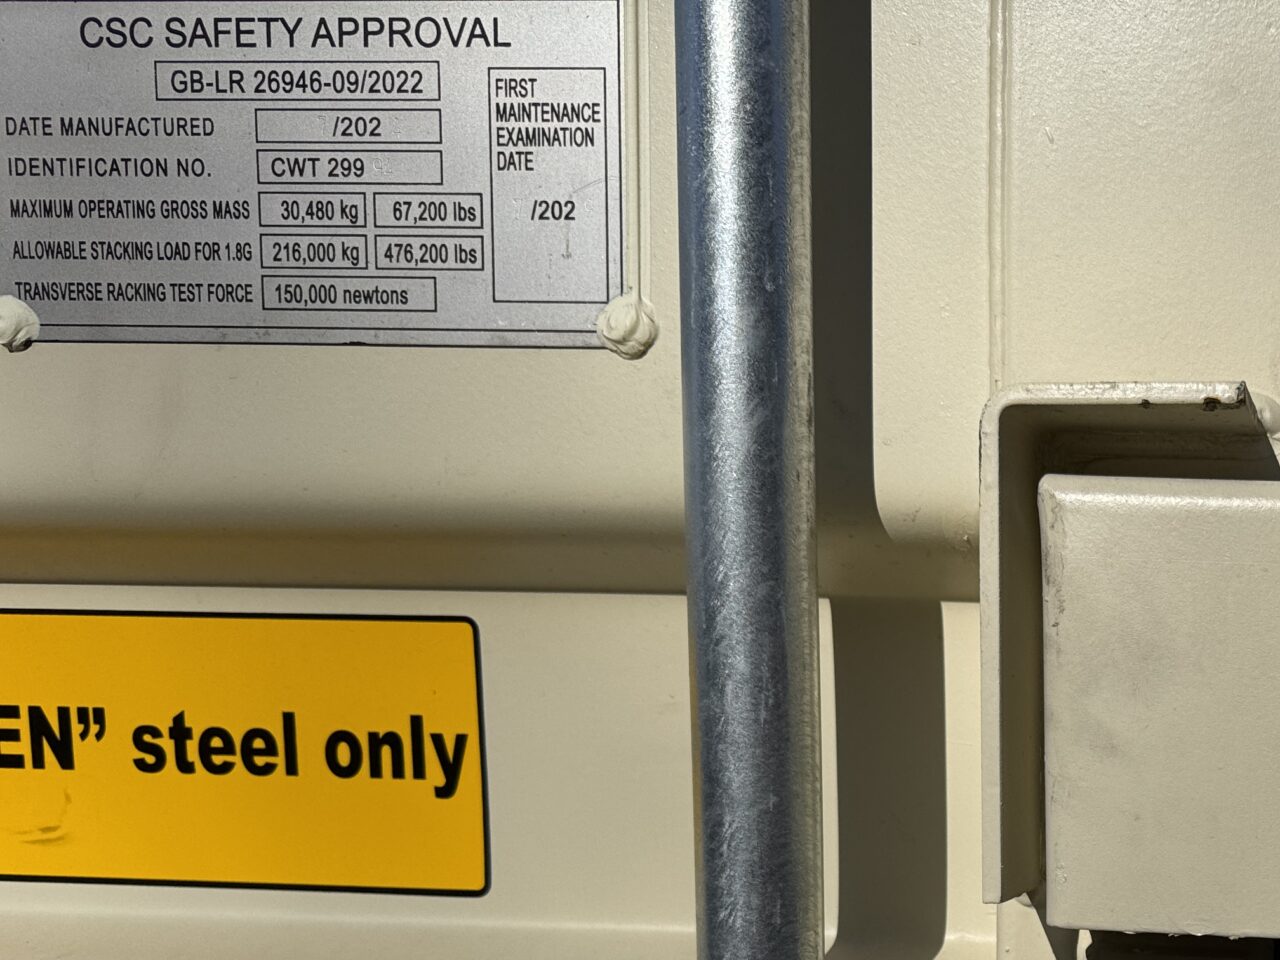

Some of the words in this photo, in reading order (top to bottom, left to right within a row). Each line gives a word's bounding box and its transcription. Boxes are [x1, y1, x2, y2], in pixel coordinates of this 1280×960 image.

[80, 17, 153, 48] CSC
[165, 17, 302, 48] SAFETY
[311, 17, 511, 48] APPROVAL
[171, 70, 245, 93] GB-LR
[254, 70, 422, 93] 26946-09/2022
[496, 79, 537, 98] FIRST
[496, 103, 600, 122] MAINTENANCE
[6, 117, 53, 136] DATE
[60, 117, 214, 136] MANUFACTURED
[497, 127, 594, 147] EXAMINATION
[9, 158, 167, 177] IDENTIFICATION
[177, 158, 211, 177] NO.
[271, 158, 320, 177] CWT
[497, 152, 534, 171] DATE
[10, 200, 73, 218] MAXIMUM
[79, 200, 155, 219] OPERATING
[161, 200, 208, 219] GROSS
[213, 201, 249, 219] MASS
[281, 201, 335, 224] 30,480
[340, 200, 359, 224] kg
[393, 201, 447, 224] 67,200
[453, 202, 476, 222] lbs
[13, 241, 87, 259] ALLOWABLE
[91, 241, 153, 260] STACKING
[157, 242, 190, 260] LOAD
[195, 242, 221, 261] FOR
[225, 243, 252, 261] 1.8G
[273, 243, 335, 264] 216,000
[342, 242, 359, 266] kg
[384, 243, 448, 266] 476,200
[455, 244, 477, 264] lbs
[15, 282, 103, 301] TRANSVERSE
[107, 283, 166, 302] RACKING
[170, 283, 203, 302] TEST
[208, 284, 253, 302] FORCE
[276, 284, 337, 306] 150,000
[344, 286, 408, 304] newtons
[132, 711, 298, 776] steel
[325, 715, 468, 799] only
